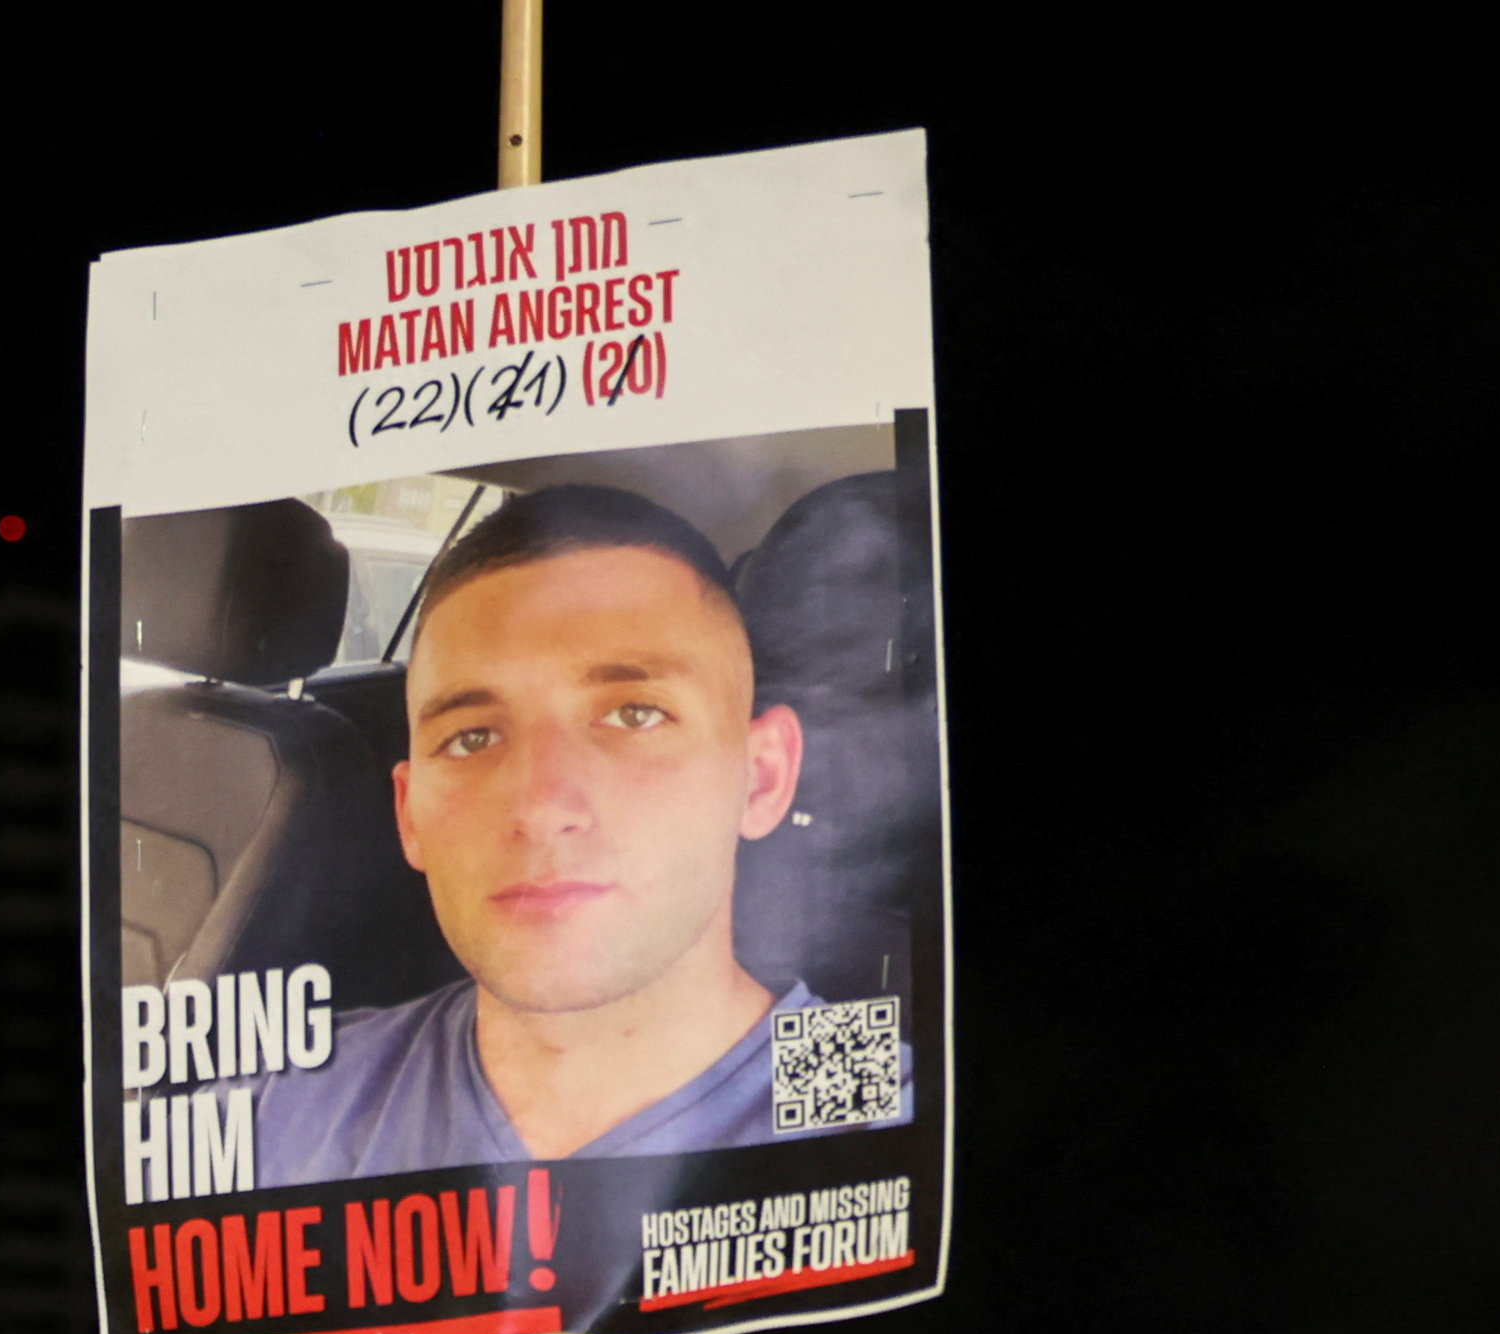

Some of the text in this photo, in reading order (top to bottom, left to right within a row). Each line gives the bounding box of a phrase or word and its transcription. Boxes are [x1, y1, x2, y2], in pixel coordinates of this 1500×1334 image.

[386, 211, 628, 303] מתן אנגרסט
[337, 269, 680, 377] MATAN ANGREST
[120, 962, 333, 1091] BRING
[122, 1088, 257, 1205] HIM
[642, 1176, 911, 1249] HOSTAGES AND MISSING
[643, 1210, 910, 1300] FAMILIES FORUM
[128, 1205, 325, 1334] HOME
